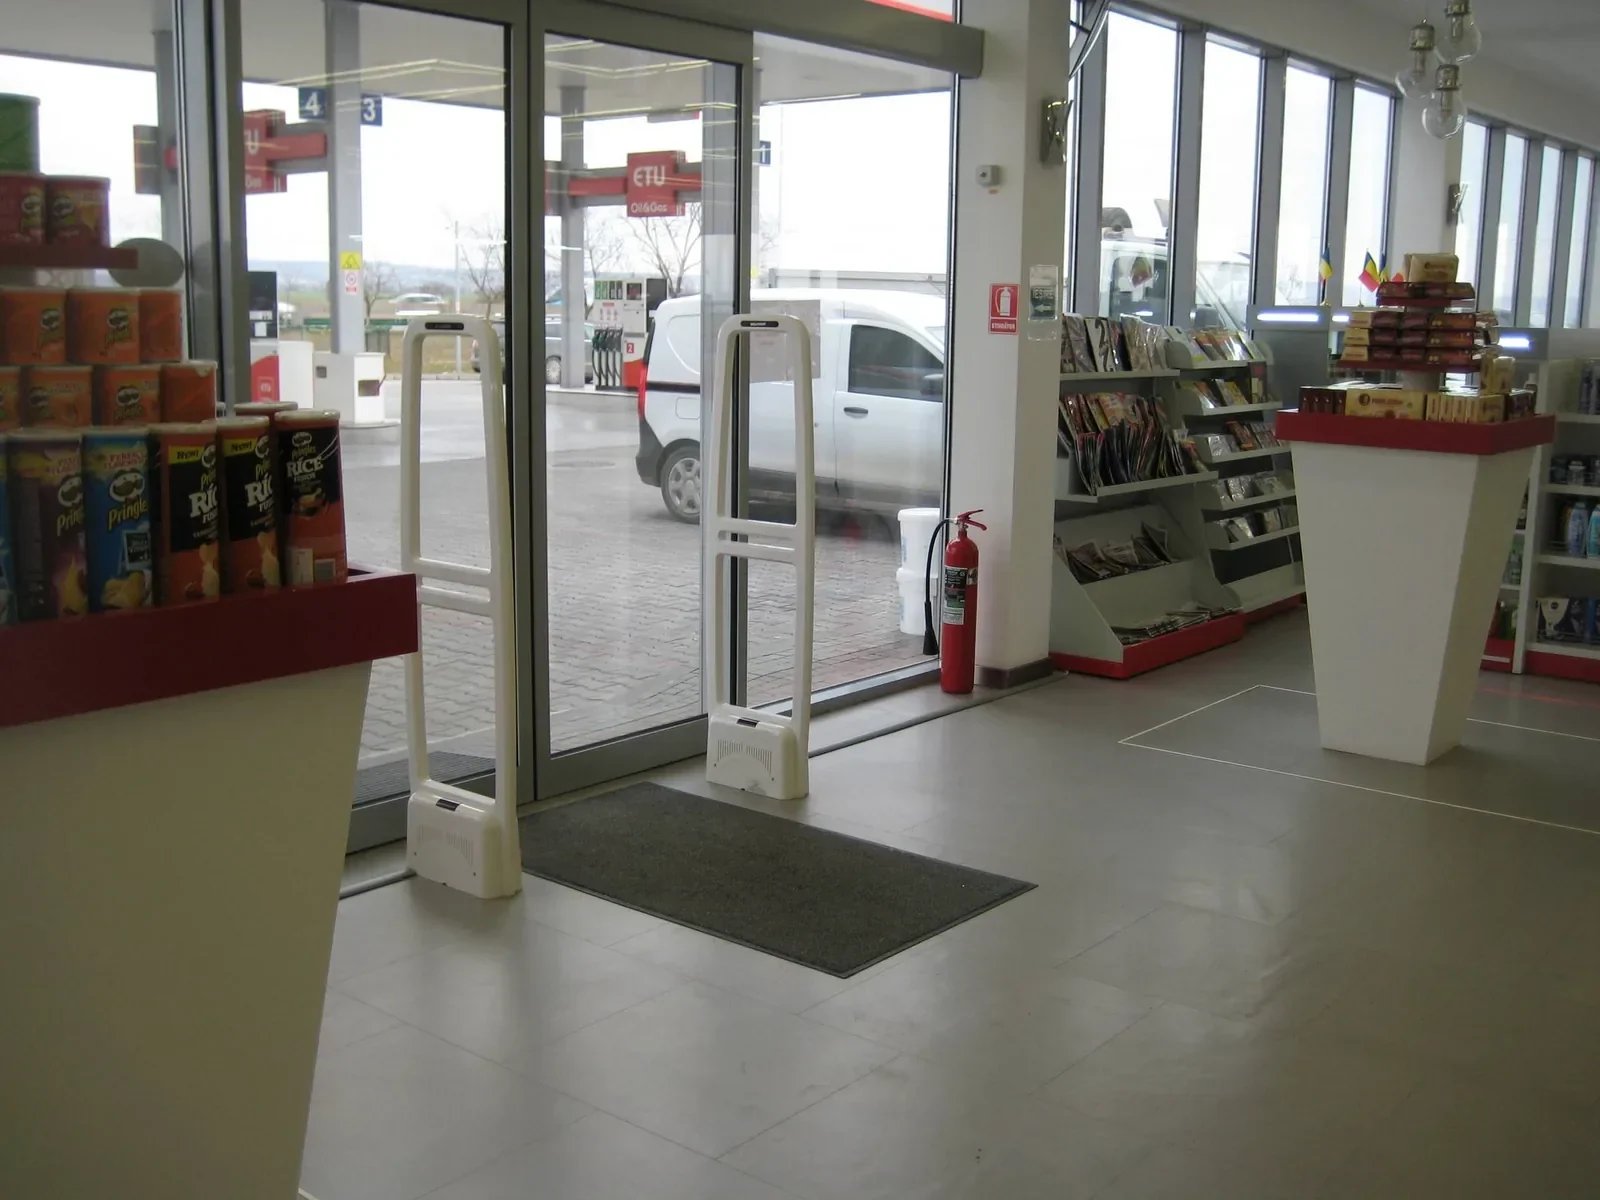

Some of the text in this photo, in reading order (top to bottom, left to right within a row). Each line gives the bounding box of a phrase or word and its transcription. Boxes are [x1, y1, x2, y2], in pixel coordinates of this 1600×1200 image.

[304, 91, 321, 116] 4
[363, 98, 376, 122] 3
[633, 165, 666, 188] ETU
[630, 201, 669, 213] Oil&Gas
[627, 343, 634, 353] 2
[107, 499, 149, 531] Pringle
